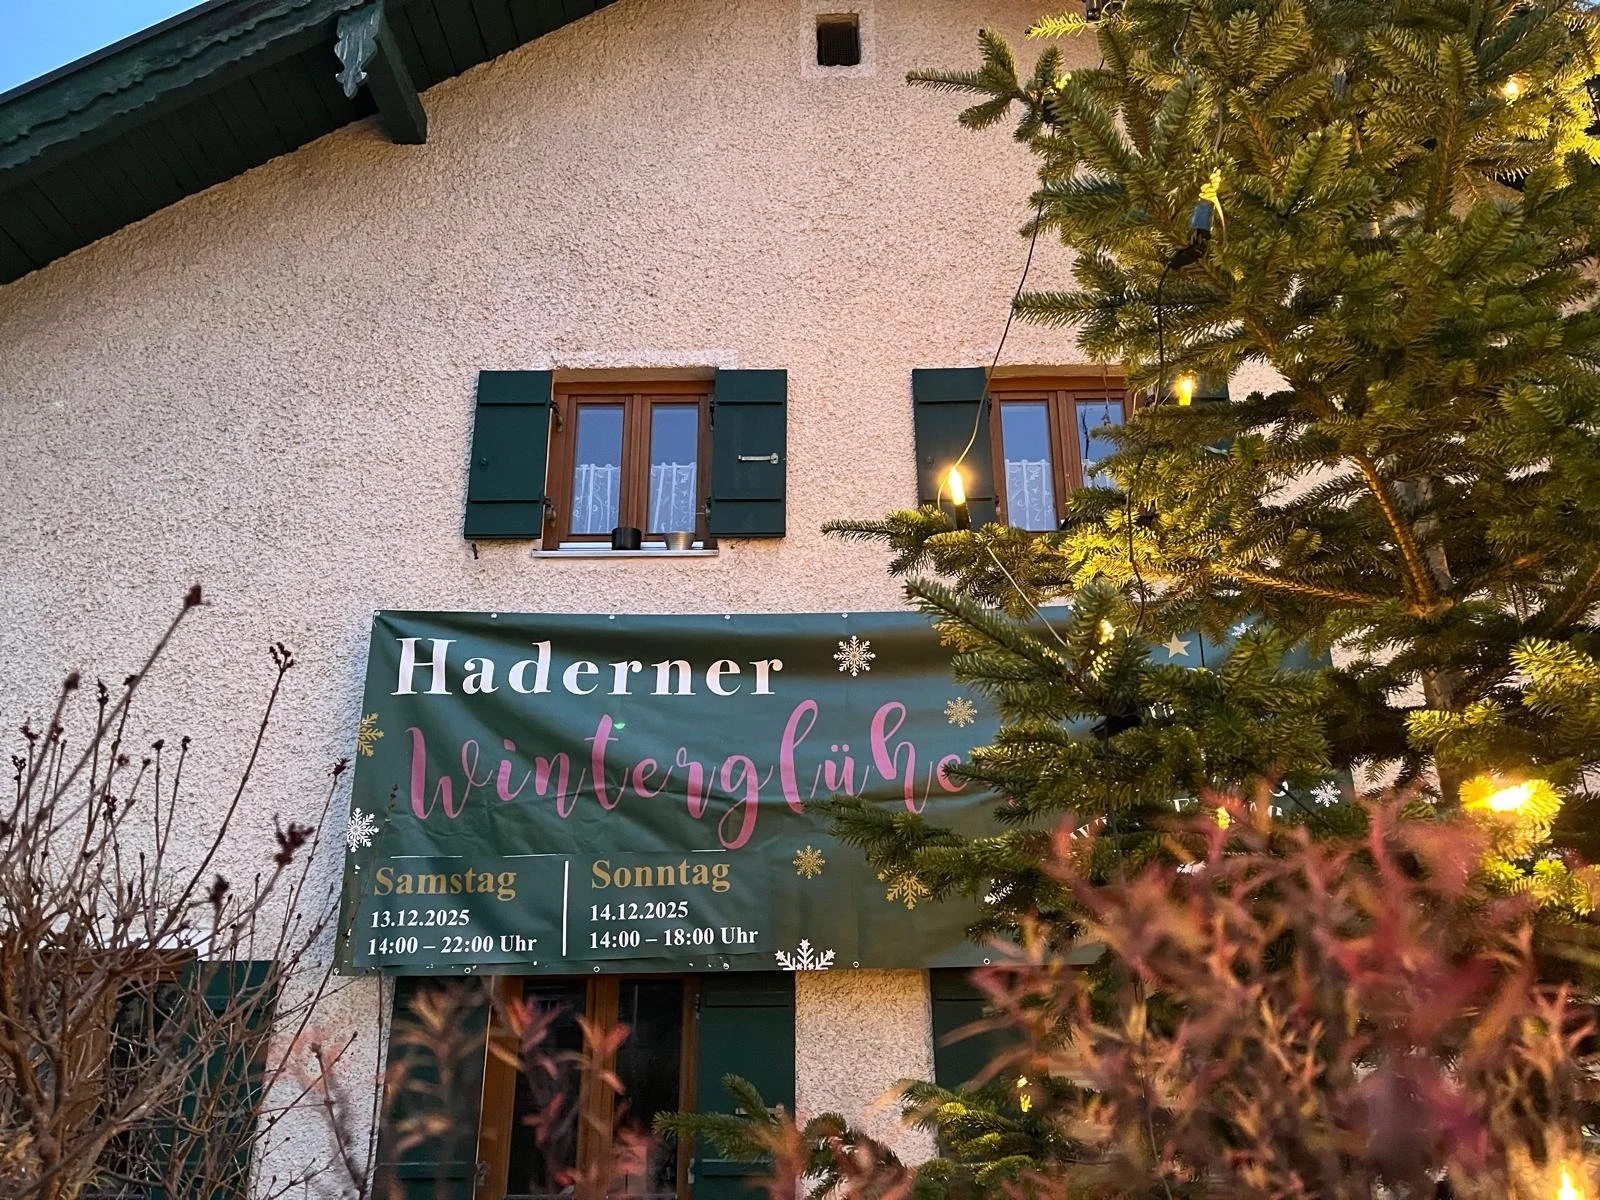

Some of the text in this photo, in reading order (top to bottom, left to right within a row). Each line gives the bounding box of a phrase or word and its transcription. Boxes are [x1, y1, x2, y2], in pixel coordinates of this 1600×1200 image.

[390, 637, 784, 696] Haderner
[406, 699, 1021, 850] Winterglühe
[373, 866, 517, 901] Samstag
[591, 859, 732, 893] Sonntag
[369, 909, 470, 928] 13.12.2025
[589, 901, 689, 922] 14.12.2025
[367, 937, 419, 956] 14:00
[441, 935, 494, 954] 22:00
[499, 934, 538, 954] Uhr
[589, 930, 641, 949] 14:00
[663, 927, 715, 946] 18:00
[720, 926, 760, 945] Uhr
